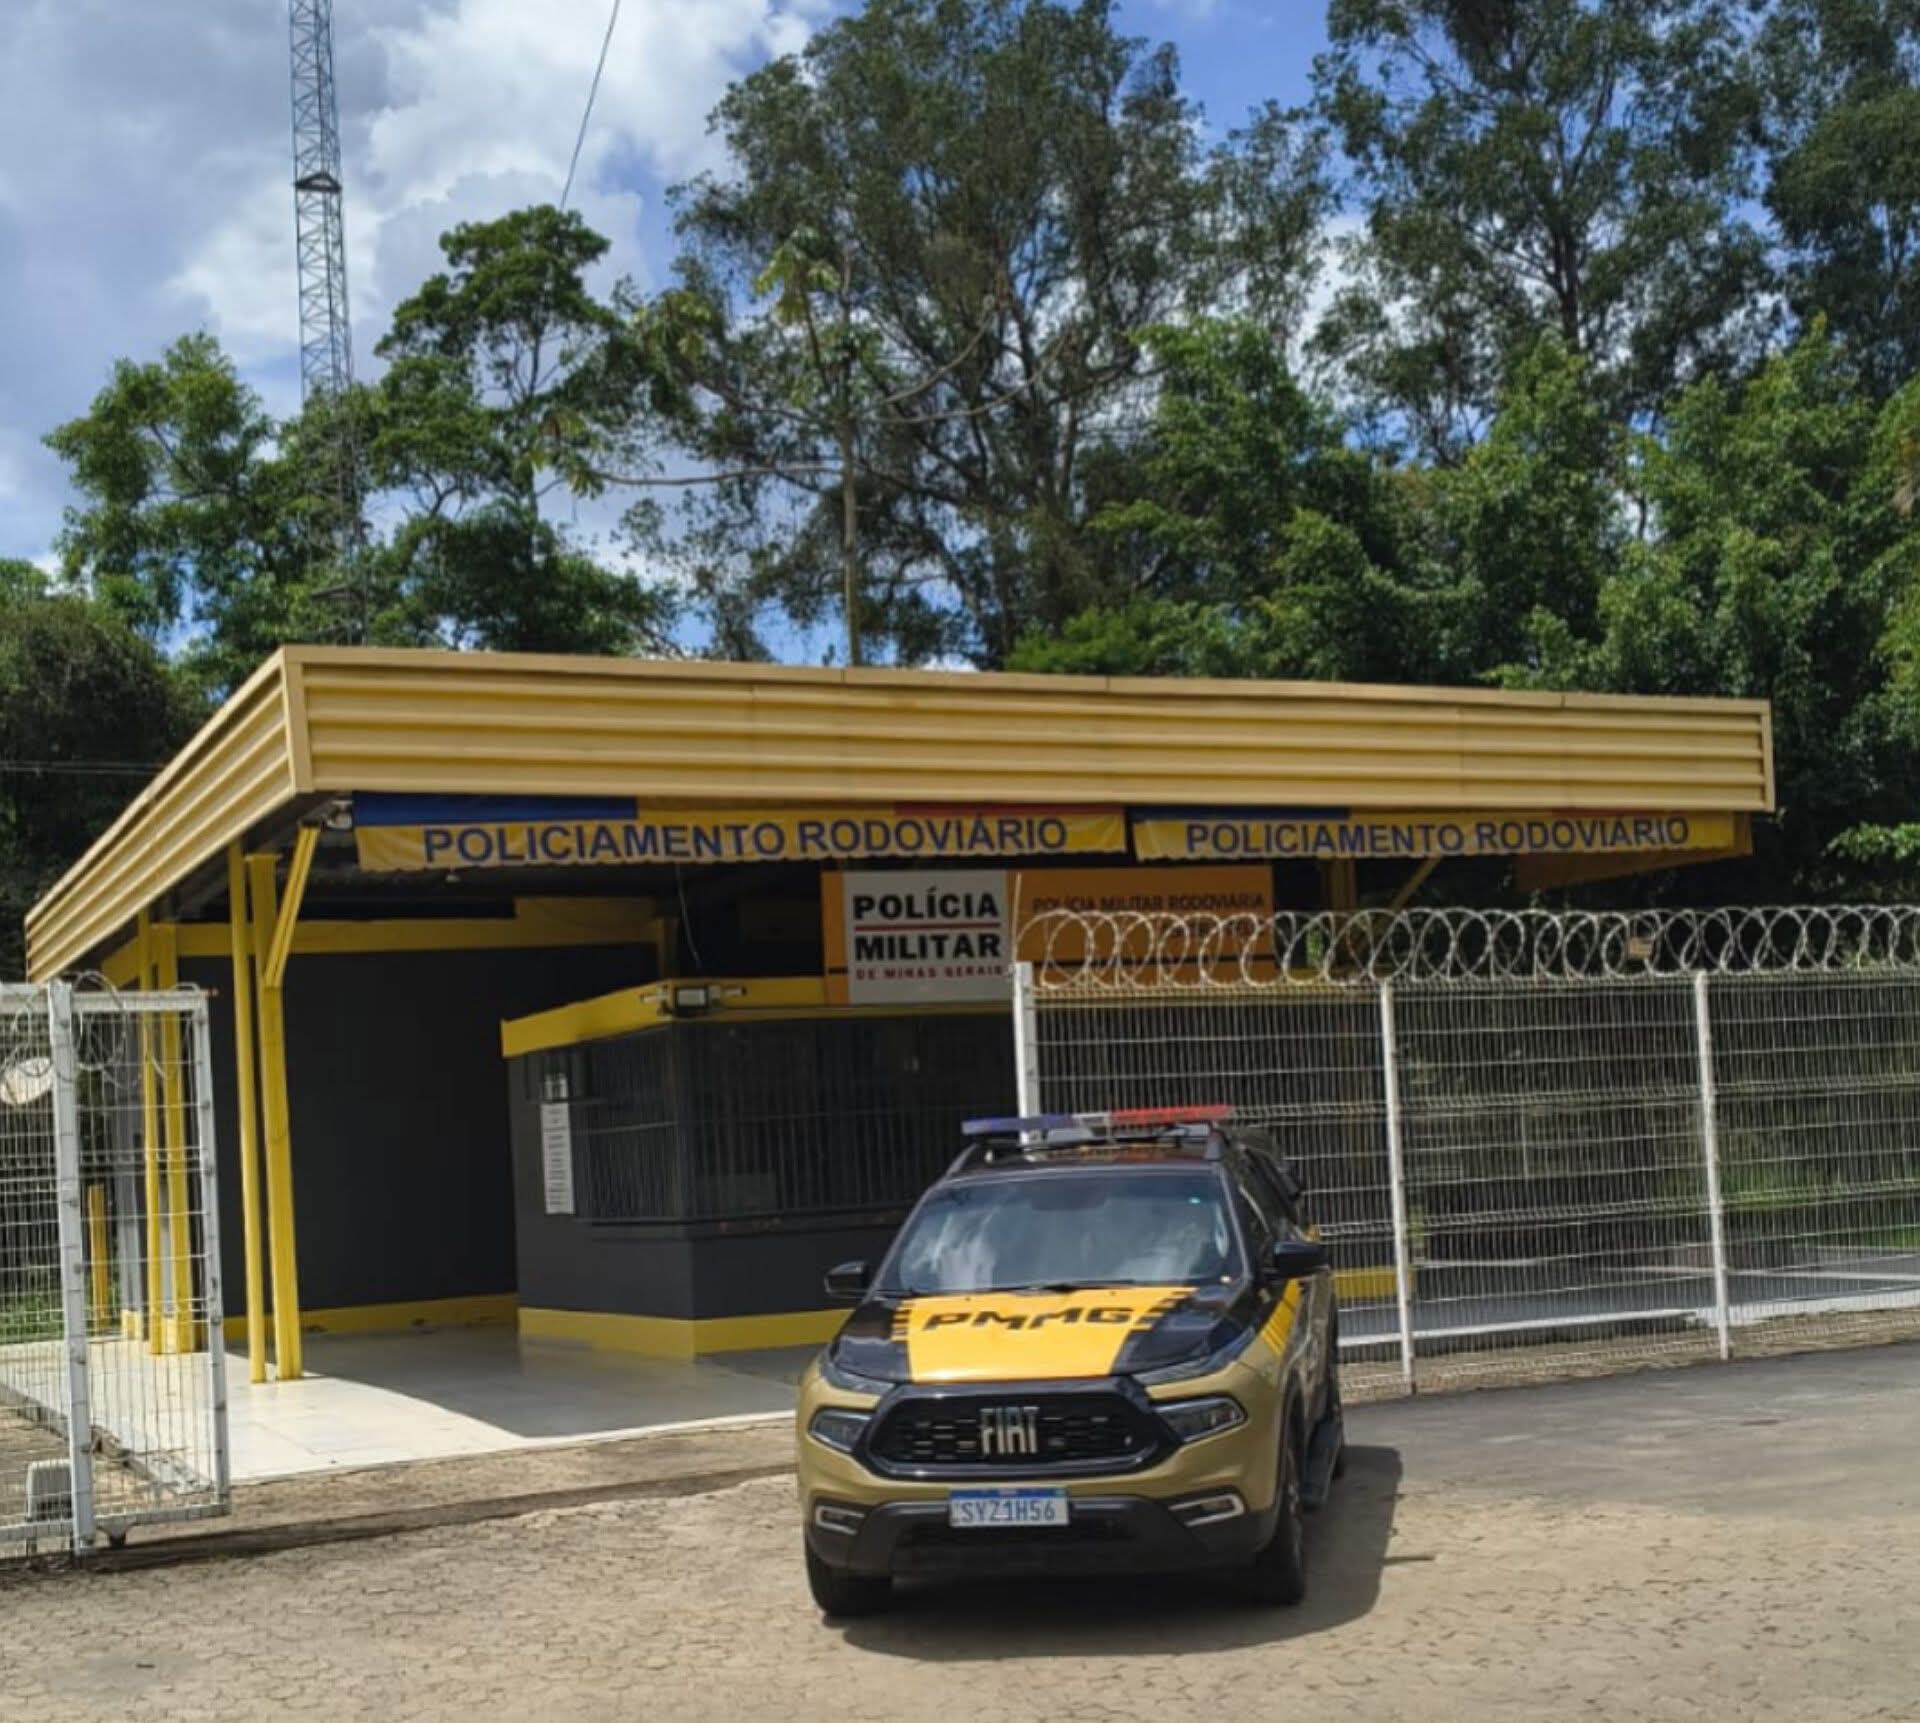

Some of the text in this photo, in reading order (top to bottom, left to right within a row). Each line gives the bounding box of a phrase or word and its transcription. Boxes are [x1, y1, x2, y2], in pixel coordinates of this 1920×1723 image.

[423, 813, 1068, 863] POLICIAMENTO RODOVIÁRIO
[1186, 822, 1464, 853] POLICIAMENTO
[852, 886, 998, 920] POLÍCIA
[854, 933, 1000, 962] MILITAR
[856, 964, 1003, 980] DE MINAS GERAIS
[922, 1306, 1136, 1331] PMMG
[979, 1405, 1041, 1455] FIAT
